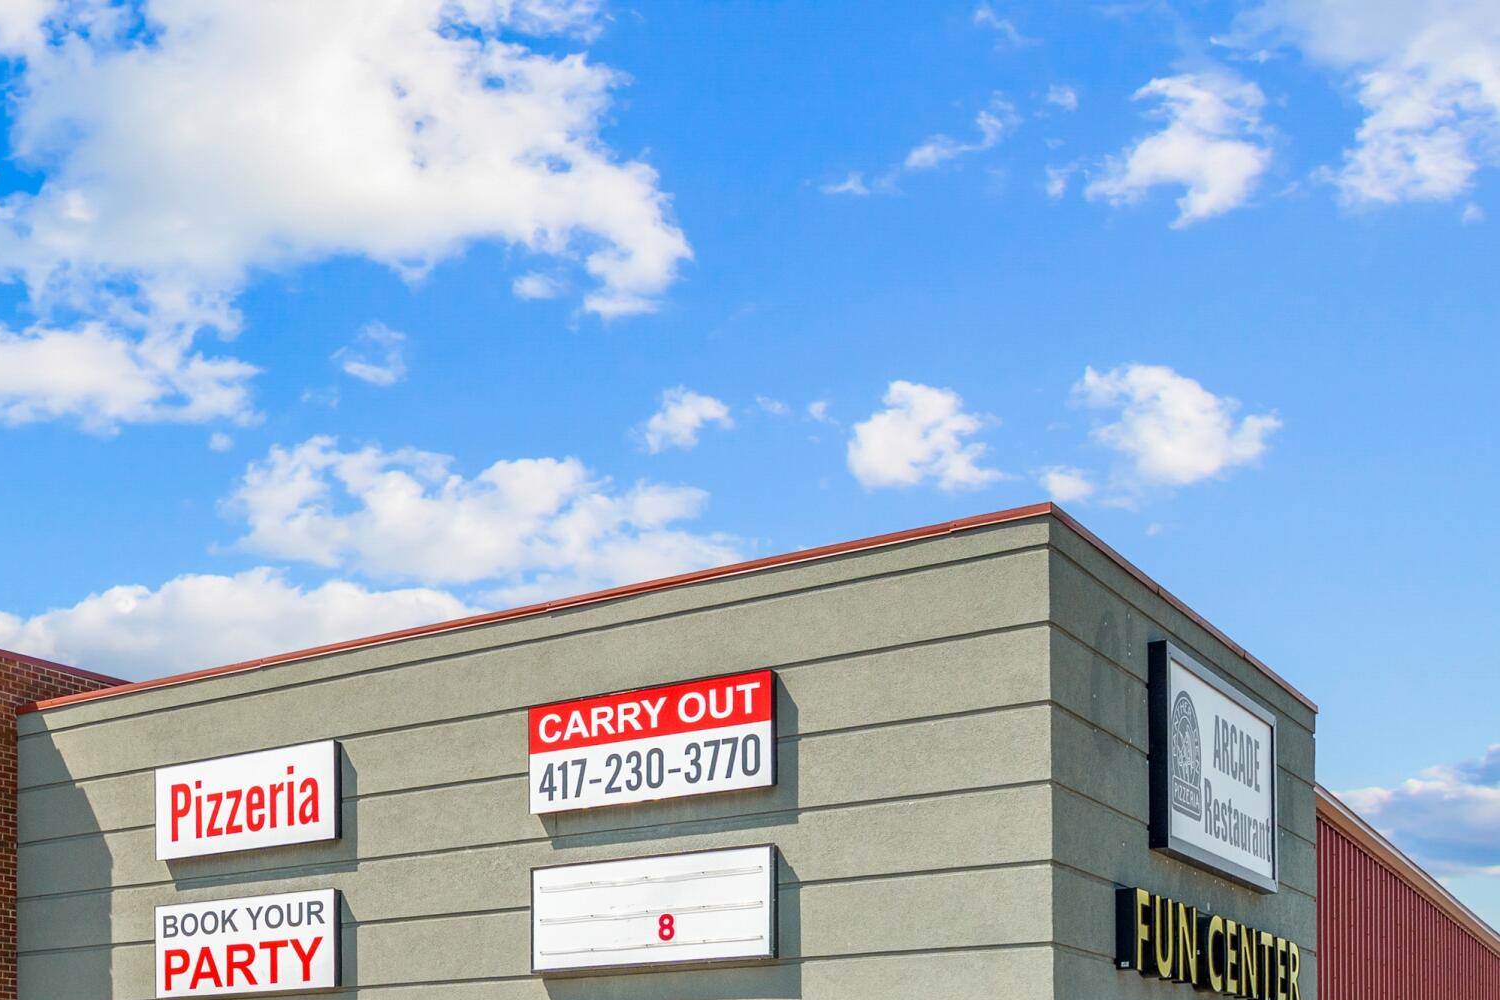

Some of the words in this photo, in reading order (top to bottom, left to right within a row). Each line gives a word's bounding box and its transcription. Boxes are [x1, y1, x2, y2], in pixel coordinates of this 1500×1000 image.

[538, 697, 667, 743] CARRY
[676, 682, 761, 725] OUT
[538, 732, 761, 802] 417-230-3770
[1213, 714, 1261, 793] ARCADE
[170, 766, 319, 842] Pizzeria
[1203, 777, 1271, 864] Restaurant
[162, 908, 239, 938] BOOK
[245, 899, 325, 931] YOUR
[658, 913, 675, 941] 8
[1135, 887, 1198, 985] FUN
[163, 936, 324, 991] PARTY
